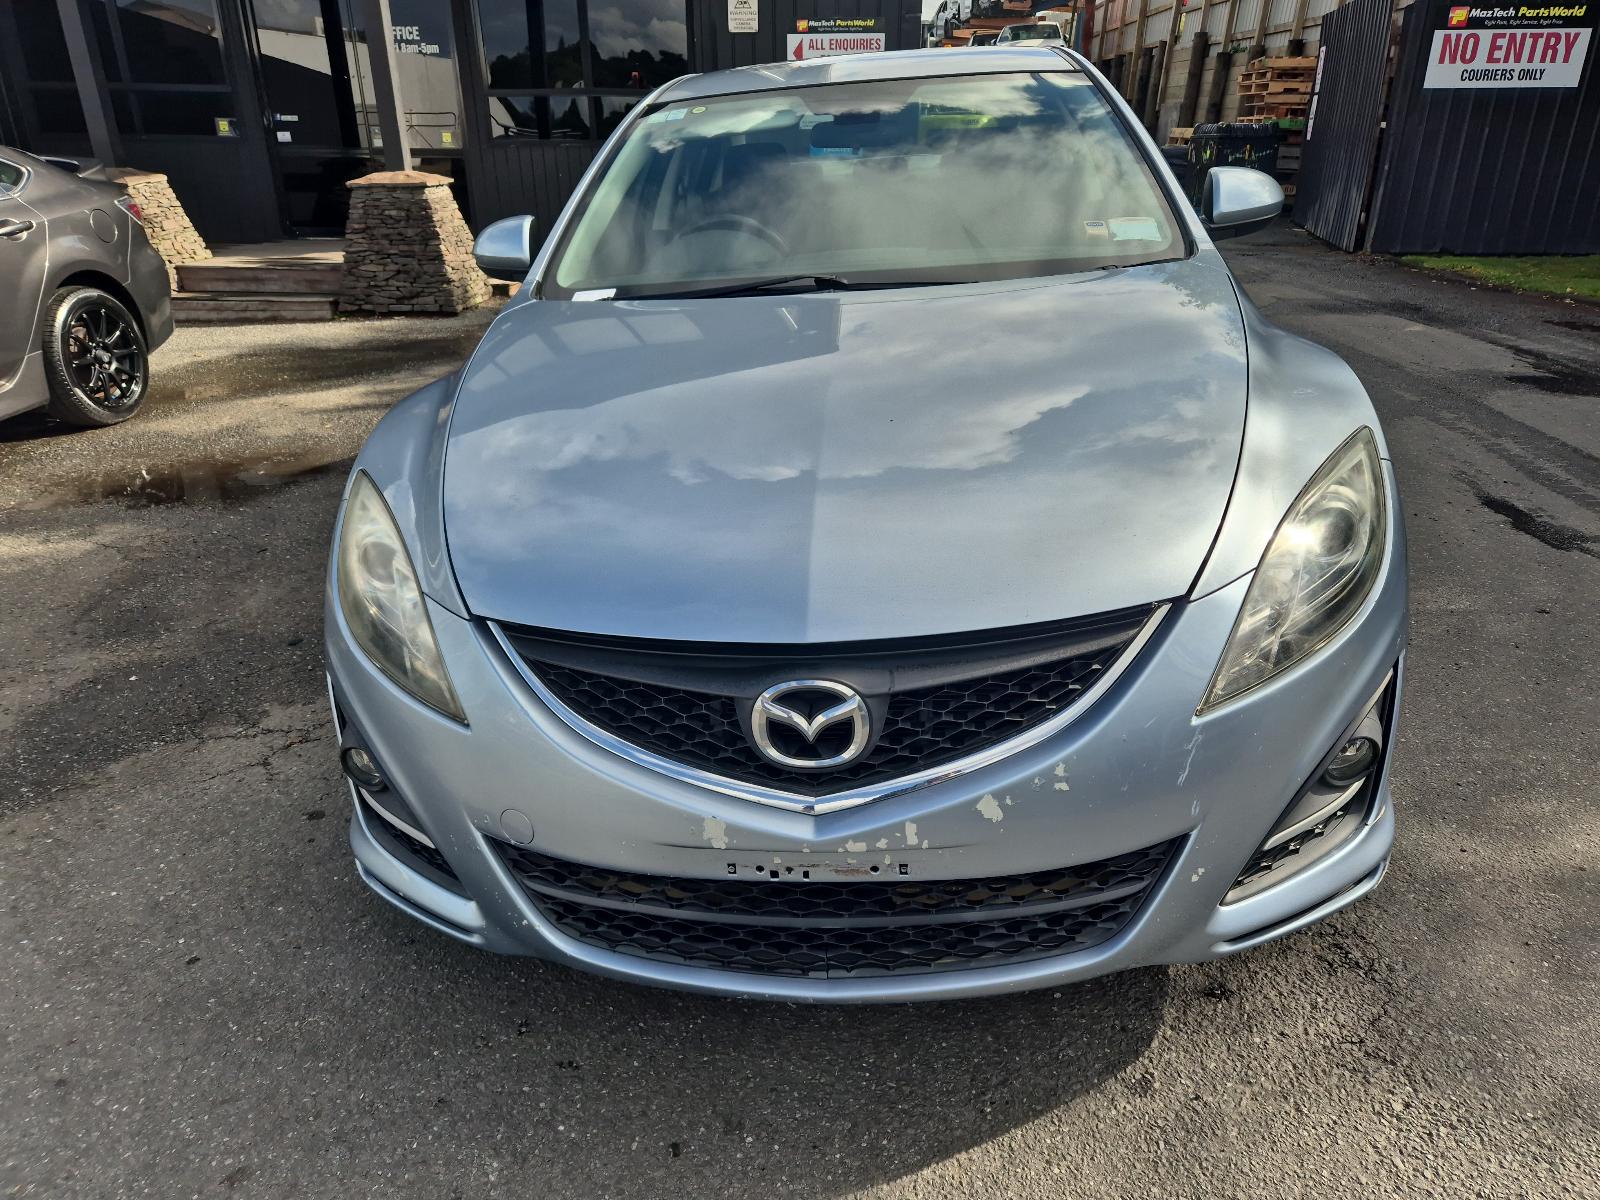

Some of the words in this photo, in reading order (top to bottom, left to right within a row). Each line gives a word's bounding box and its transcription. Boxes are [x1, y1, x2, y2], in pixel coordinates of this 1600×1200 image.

[1469, 7, 1516, 18] MazTech
[1518, 5, 1587, 17] PartsWorld
[392, 26, 420, 40] FFICE
[400, 42, 440, 54] 8am-5pm
[808, 38, 825, 51] ALL
[829, 38, 882, 51] ENQUIRIES
[1438, 32, 1481, 65] NO
[1486, 31, 1582, 64] ENTRY
[1460, 68, 1515, 82] COURIERS
[1517, 68, 1546, 81] ONLY
